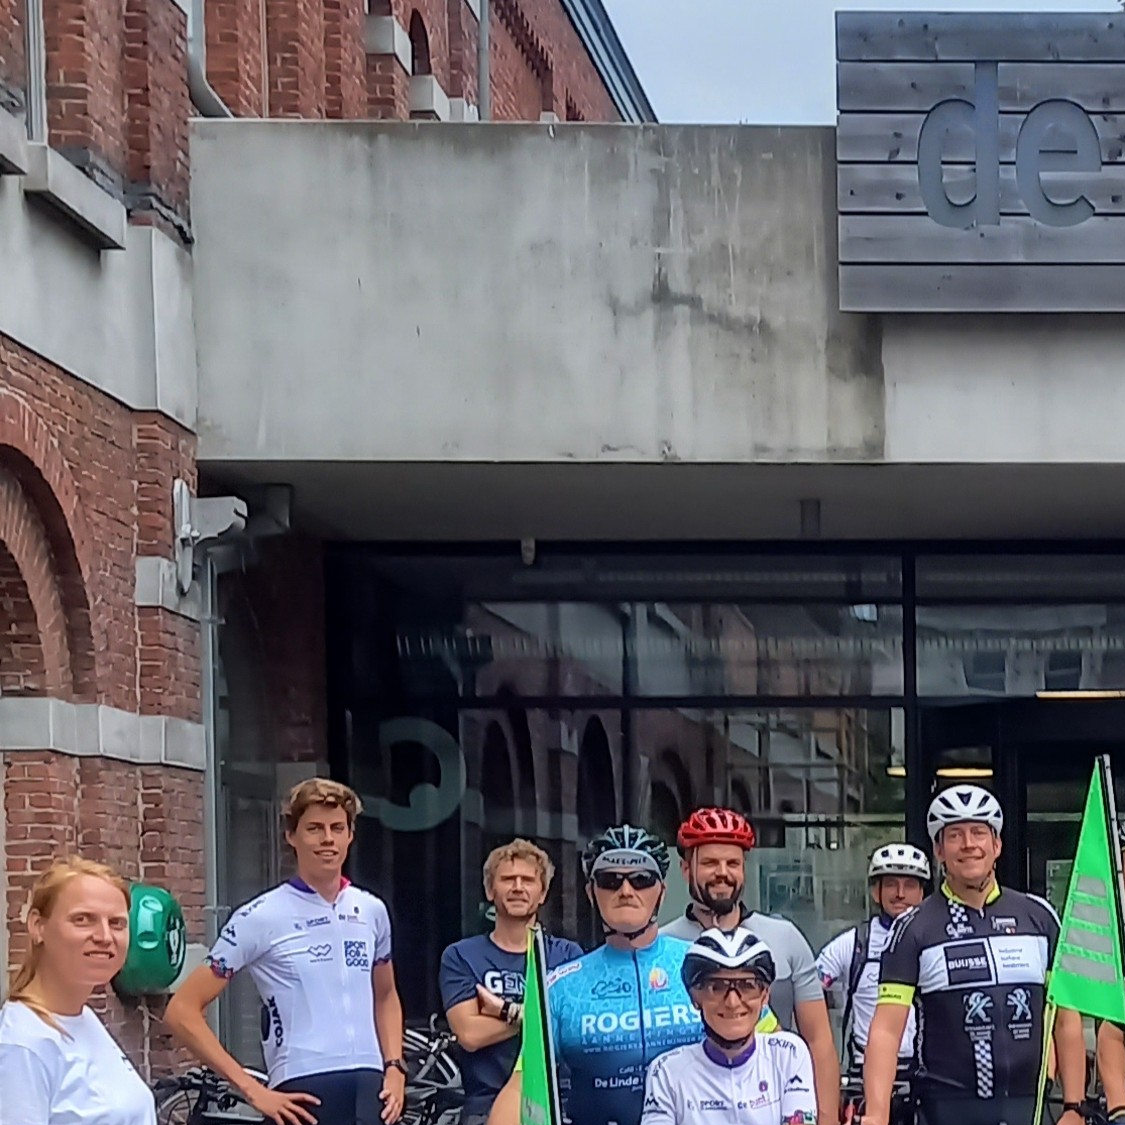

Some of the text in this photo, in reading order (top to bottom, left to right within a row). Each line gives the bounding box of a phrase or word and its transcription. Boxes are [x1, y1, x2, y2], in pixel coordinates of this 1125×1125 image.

[917, 61, 1102, 228] de
[594, 1078, 608, 1088] De
[609, 1075, 640, 1088] Linde
